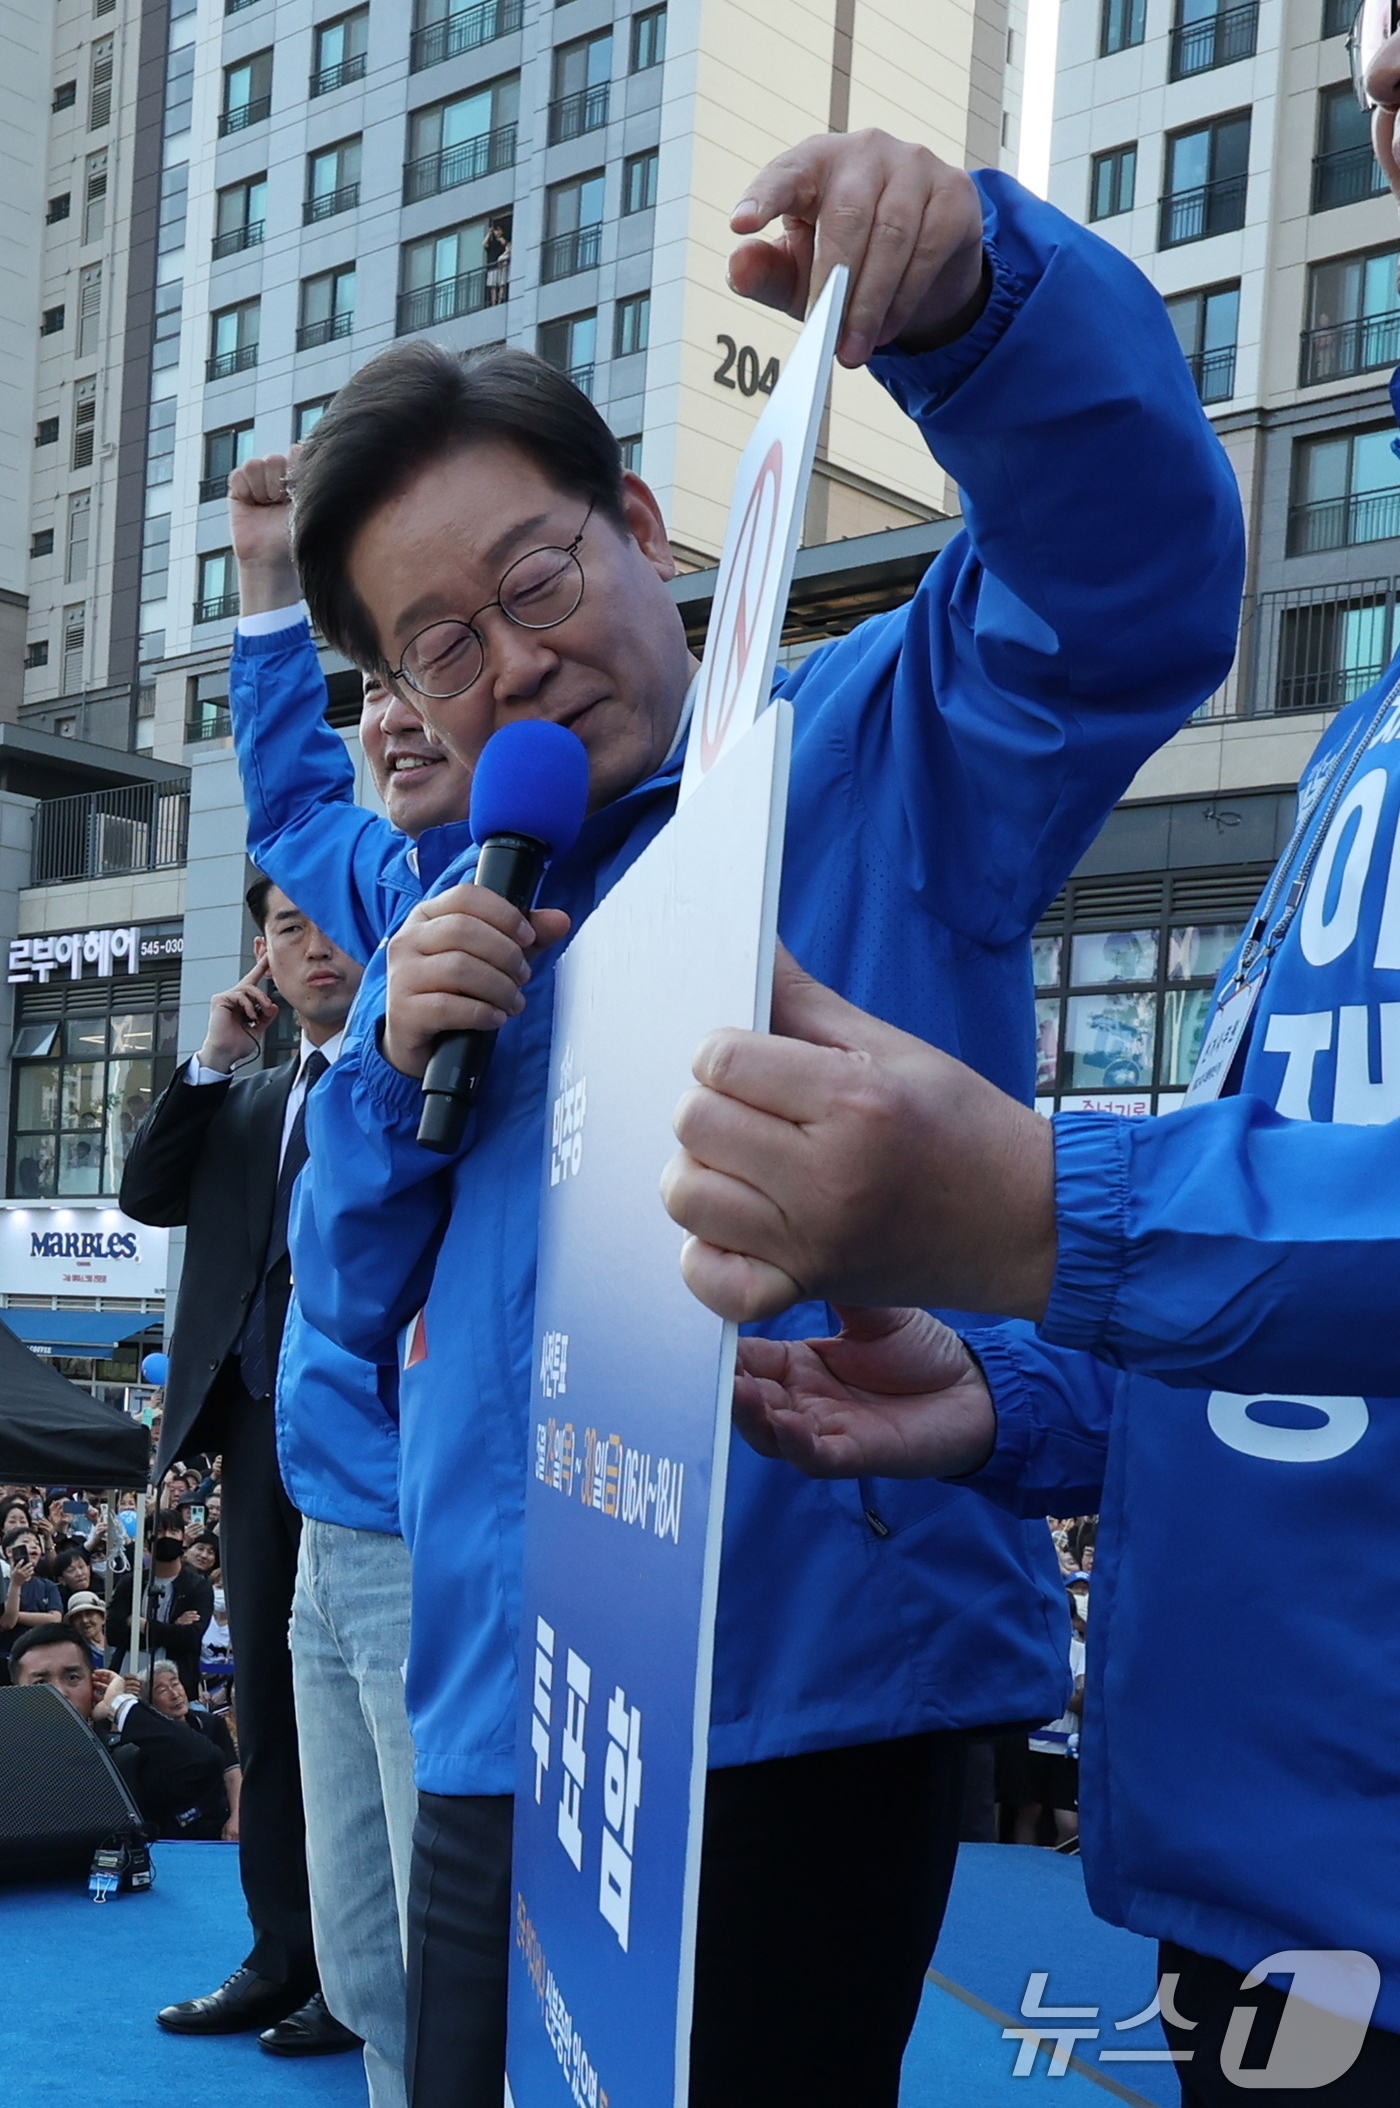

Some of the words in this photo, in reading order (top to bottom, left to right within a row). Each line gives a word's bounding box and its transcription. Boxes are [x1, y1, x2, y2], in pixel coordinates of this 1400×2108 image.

[713, 333, 780, 397] 204
[8, 926, 140, 983] 르부아헤어
[551, 1075, 587, 1187] 민주당
[539, 1330, 569, 1399] 사전투표
[531, 1615, 642, 1953] 투표함
